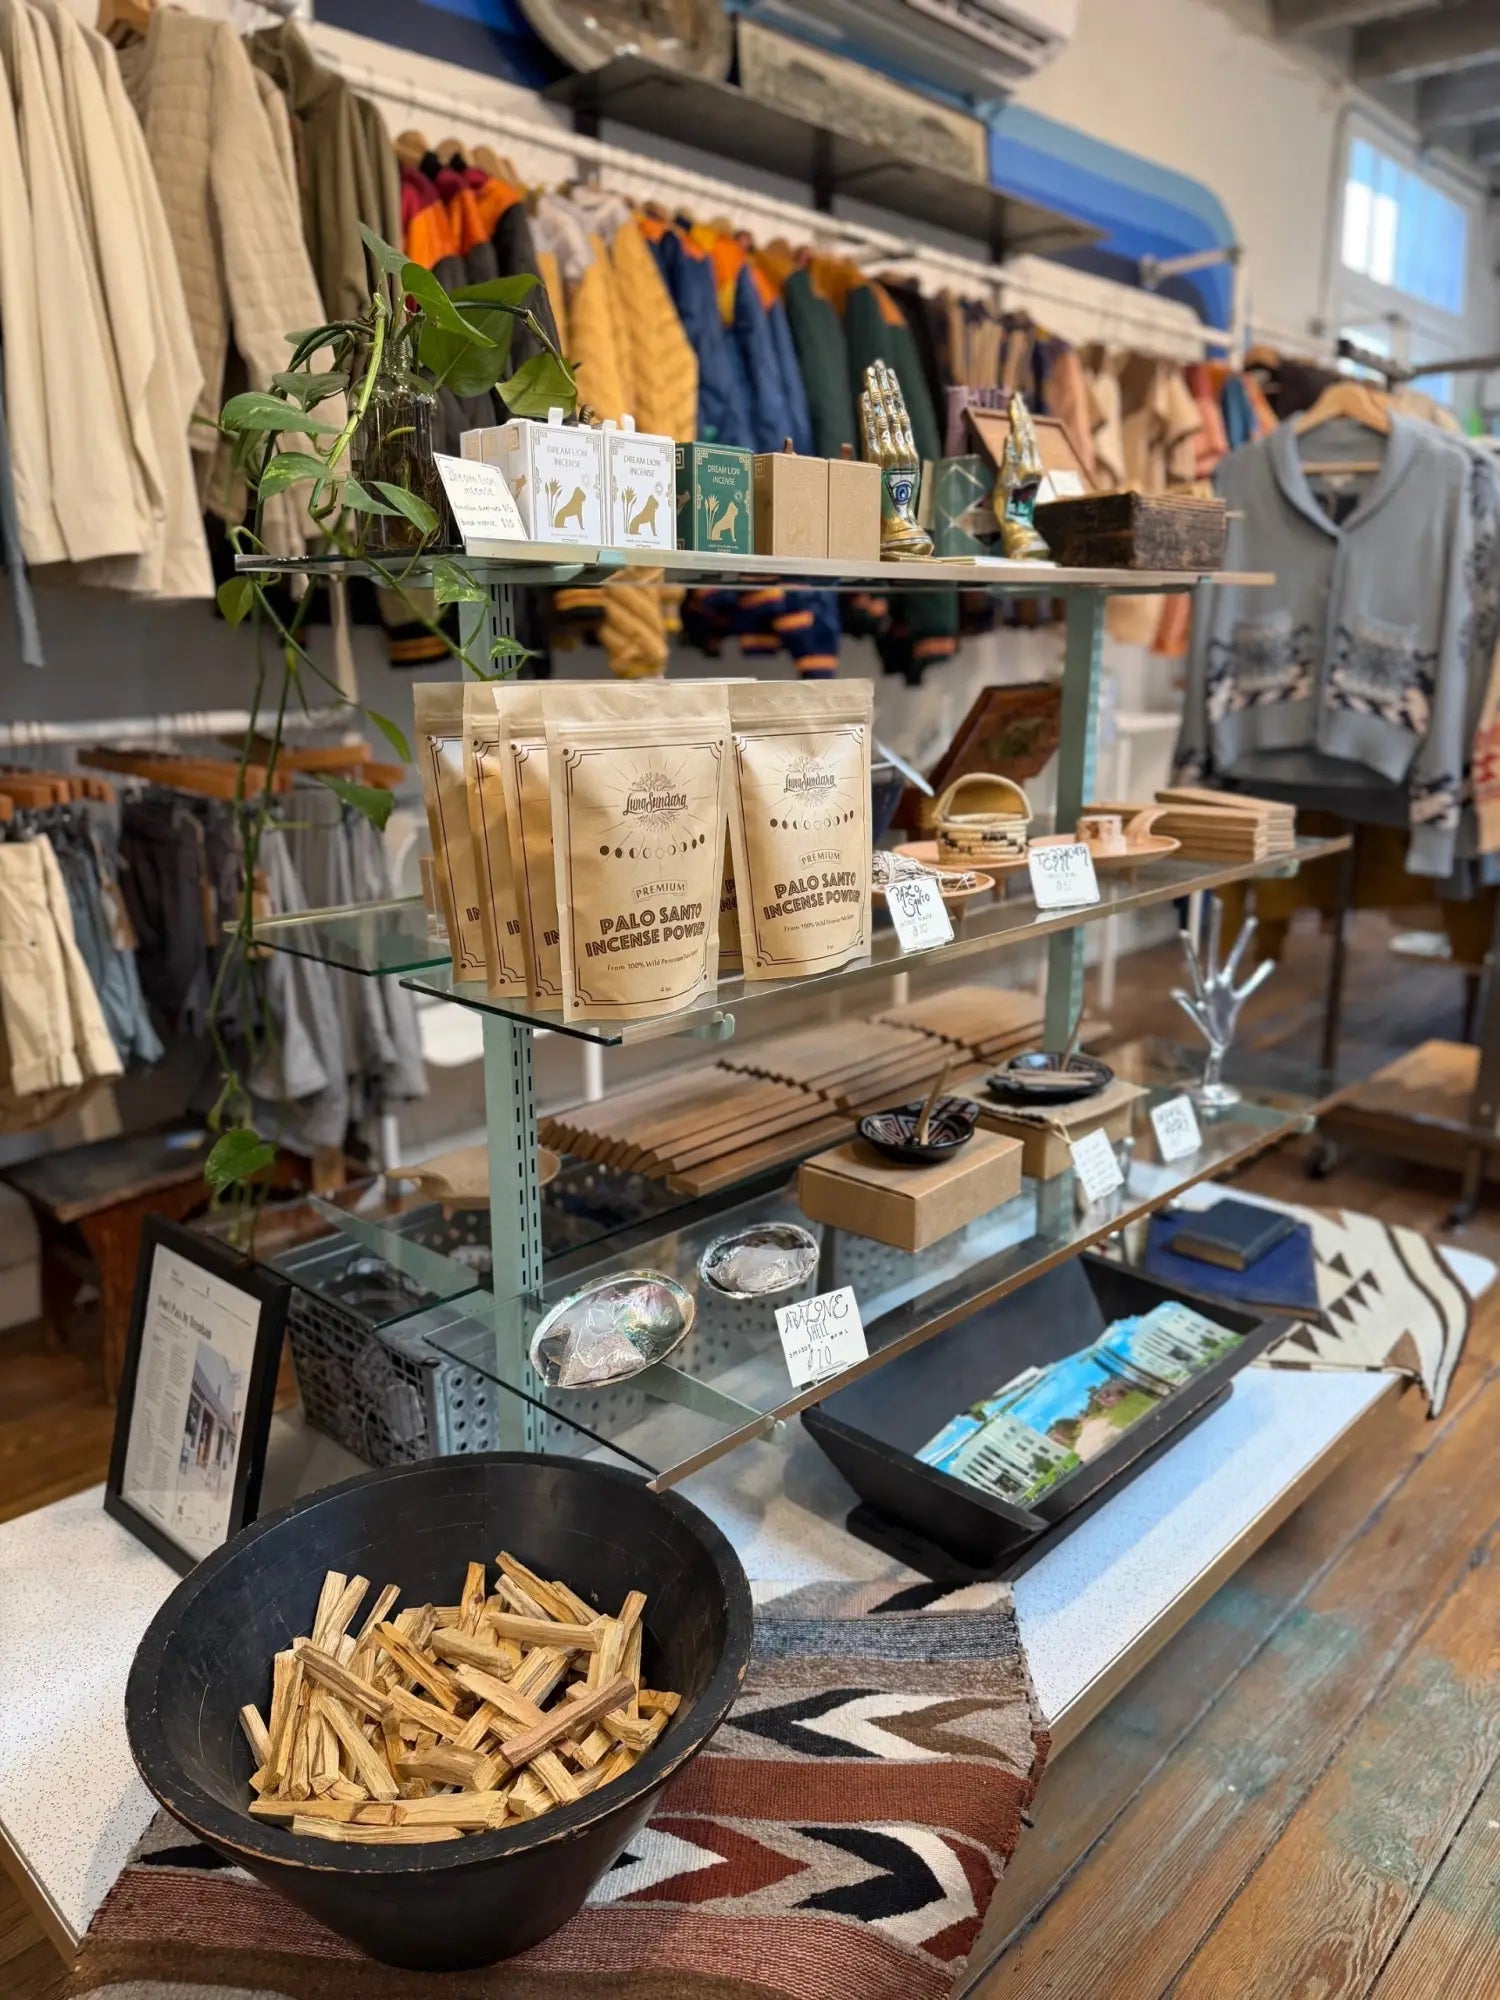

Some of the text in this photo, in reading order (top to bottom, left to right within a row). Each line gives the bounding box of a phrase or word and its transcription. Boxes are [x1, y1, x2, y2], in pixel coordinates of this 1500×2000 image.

[547, 445, 588, 457] DREAM LION
[554, 458, 580, 468] INCENSE
[623, 455, 661, 467] DREAM LION
[629, 468, 655, 478] INCENSE
[707, 464, 740, 476] DREAM LION
[712, 476, 735, 486] INCENSE
[801, 852, 840, 865] PREMIUM
[635, 882, 685, 899] PREMIUM
[774, 871, 856, 900] PALO SANTO
[763, 892, 824, 920] INCENSE
[600, 909, 656, 936] PALO
[659, 902, 702, 924] SANTO
[585, 928, 660, 958] INCENSE
[663, 921, 705, 942] POWDER
[628, 962, 645, 970] 100%
[645, 958, 660, 968] Wild
[784, 1293, 849, 1334] ABALONE
[806, 1320, 831, 1342] SHELL
